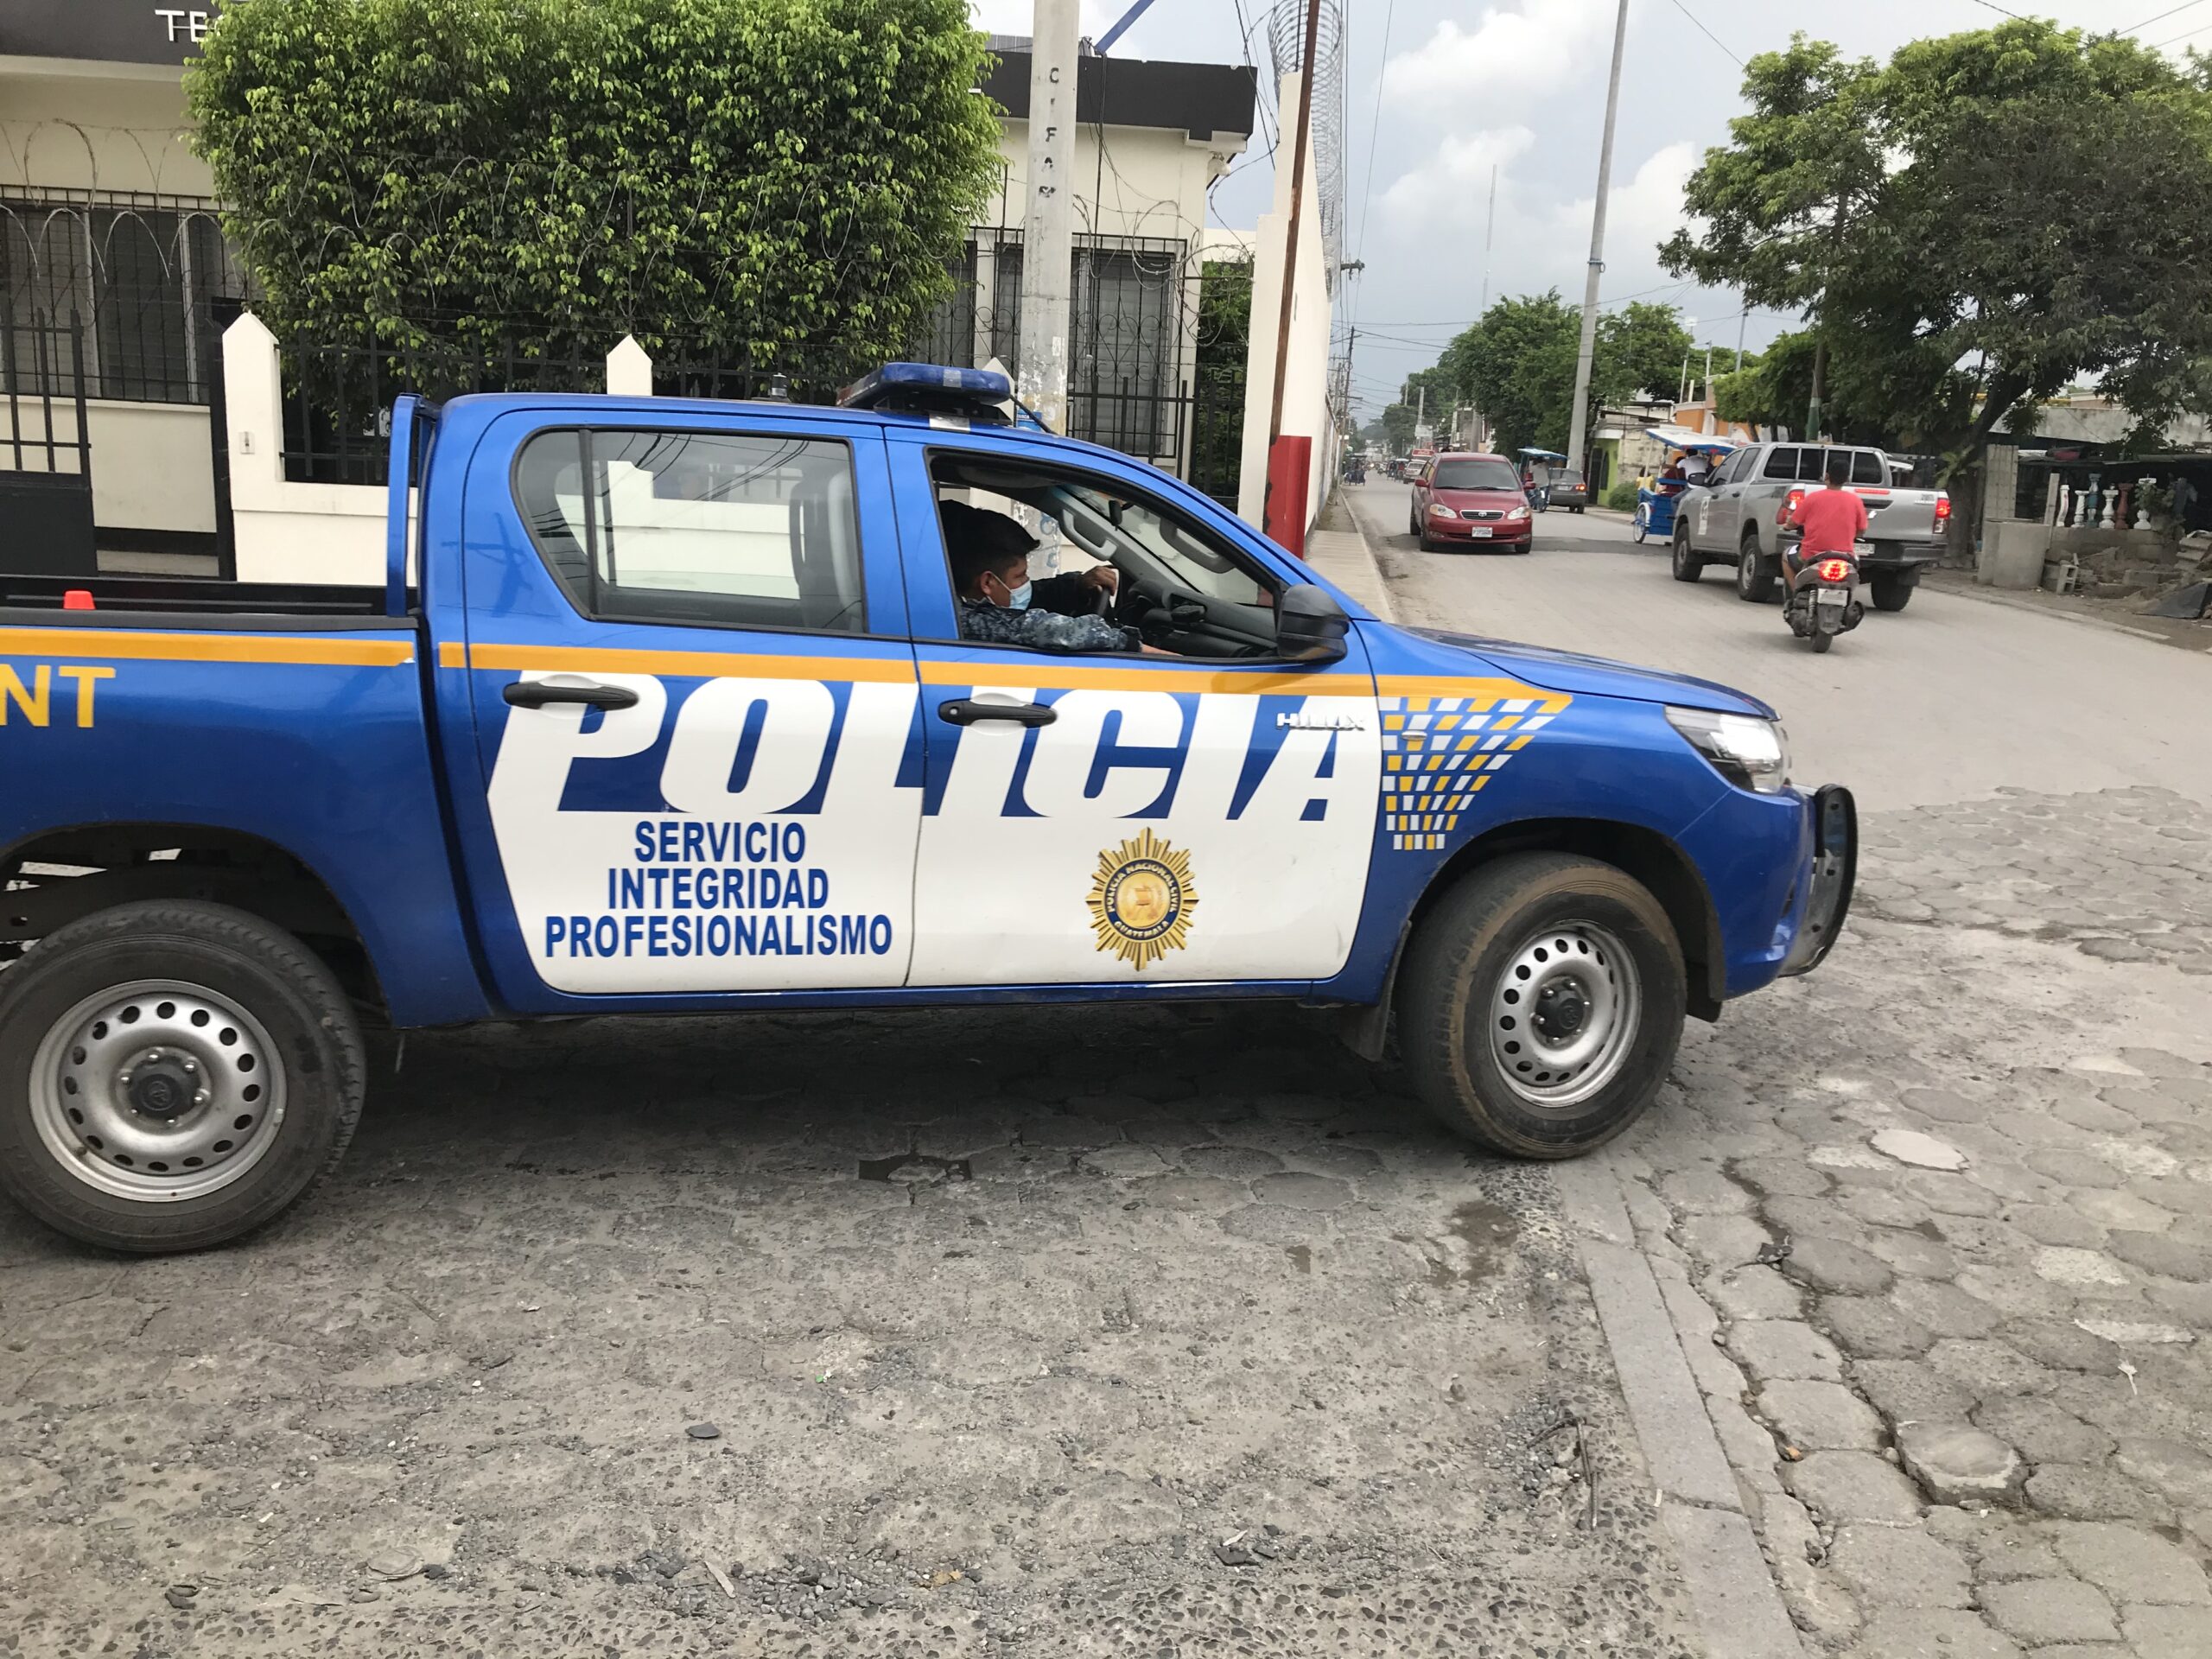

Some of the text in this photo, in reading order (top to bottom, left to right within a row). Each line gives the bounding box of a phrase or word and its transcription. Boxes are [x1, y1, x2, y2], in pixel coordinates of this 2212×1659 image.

[0, 663, 117, 728] NT
[486, 669, 1382, 822] POLICIA
[634, 821, 806, 863] SERVICIO
[608, 868, 830, 910] INTEGRIDAD
[1106, 862, 1181, 913] POLICIA NACIONAL CIVIL
[545, 914, 893, 957] PROFESIONALISMO
[1114, 920, 1169, 938] GUATEMALA
